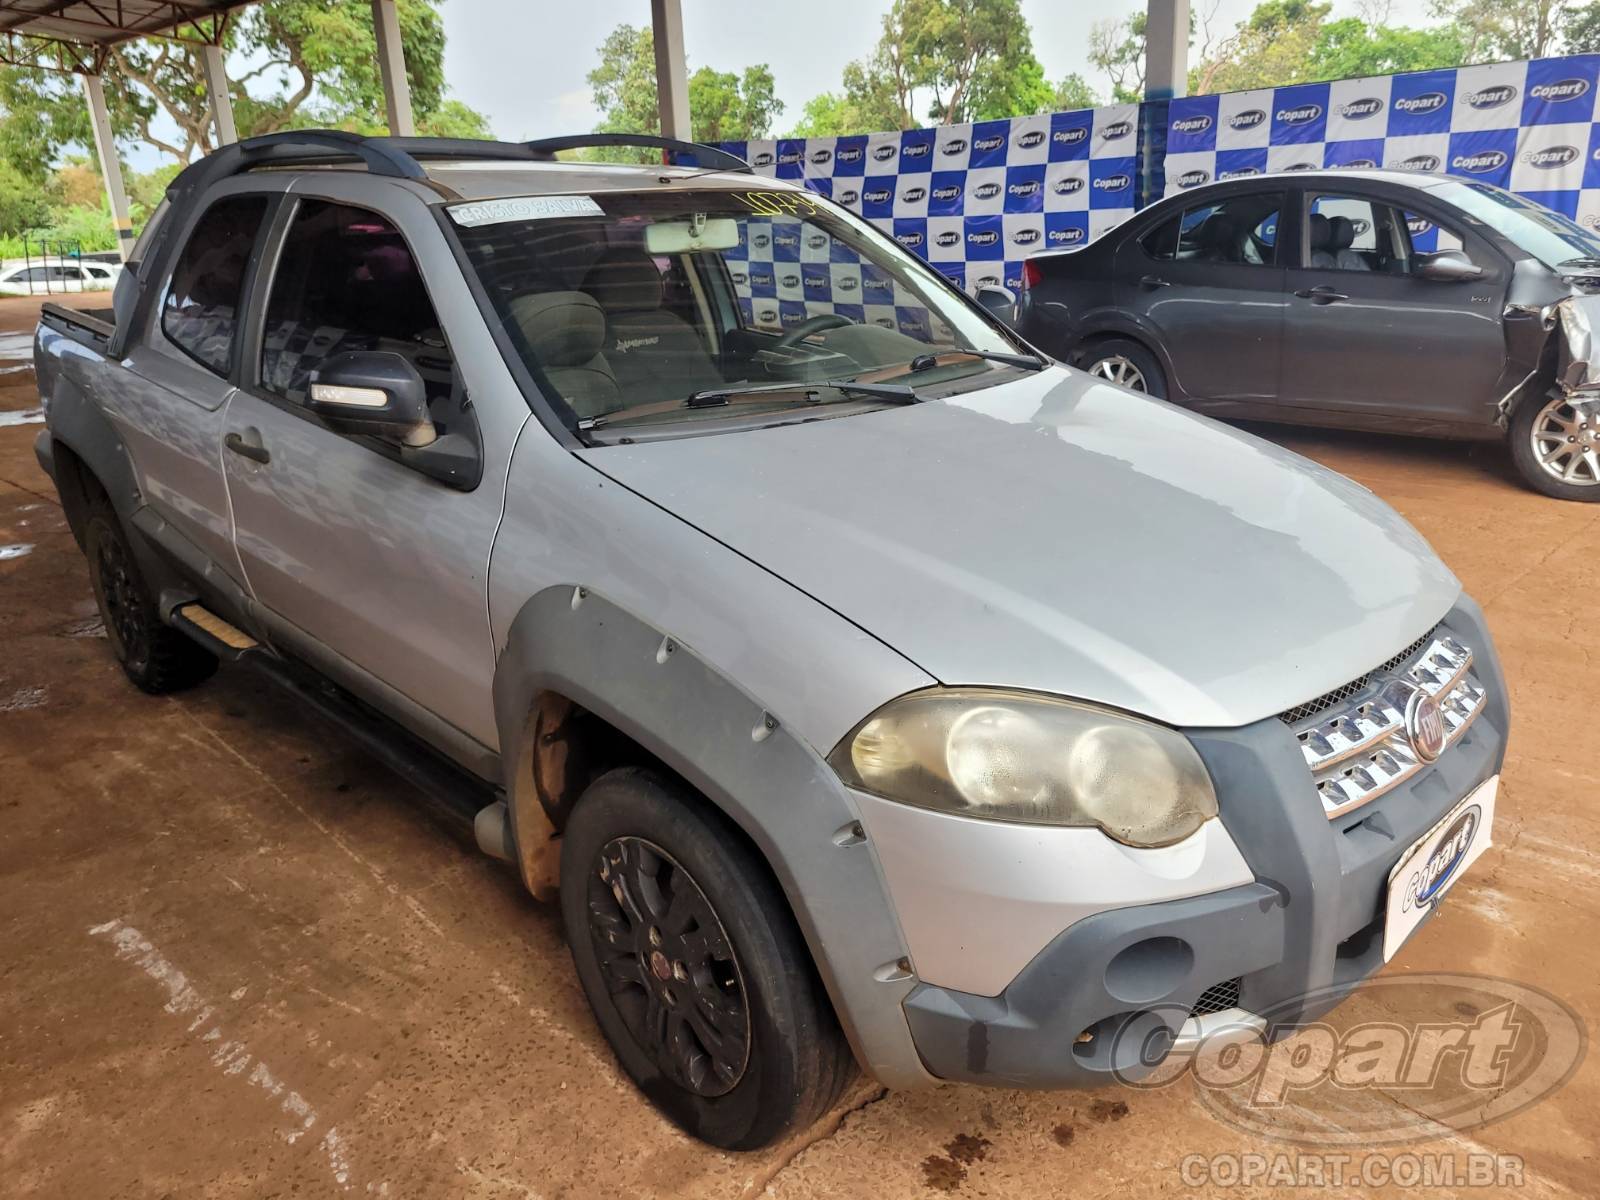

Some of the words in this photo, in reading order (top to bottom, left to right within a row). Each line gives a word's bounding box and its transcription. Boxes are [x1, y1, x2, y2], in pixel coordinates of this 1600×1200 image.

[1531, 81, 1583, 98] Copart
[1395, 94, 1441, 111] Copart
[1461, 88, 1510, 105] Copart
[1276, 107, 1317, 122] Copart
[1333, 101, 1376, 116] Copart
[1172, 119, 1207, 131] Copart
[1053, 129, 1083, 142] Copart
[974, 137, 1001, 150] Copart
[837, 151, 860, 161] Copart
[903, 145, 928, 156] Copart
[1521, 147, 1572, 165] Copart
[1453, 153, 1500, 170] Copart
[1008, 181, 1036, 195] Copart
[1093, 176, 1128, 190] Copart
[863, 191, 889, 202] Copart
[932, 186, 959, 198] Copart
[897, 232, 921, 245] Copart
[968, 233, 995, 244] Copart
[1049, 230, 1080, 242] Copart
[1403, 811, 1473, 914] Copart
